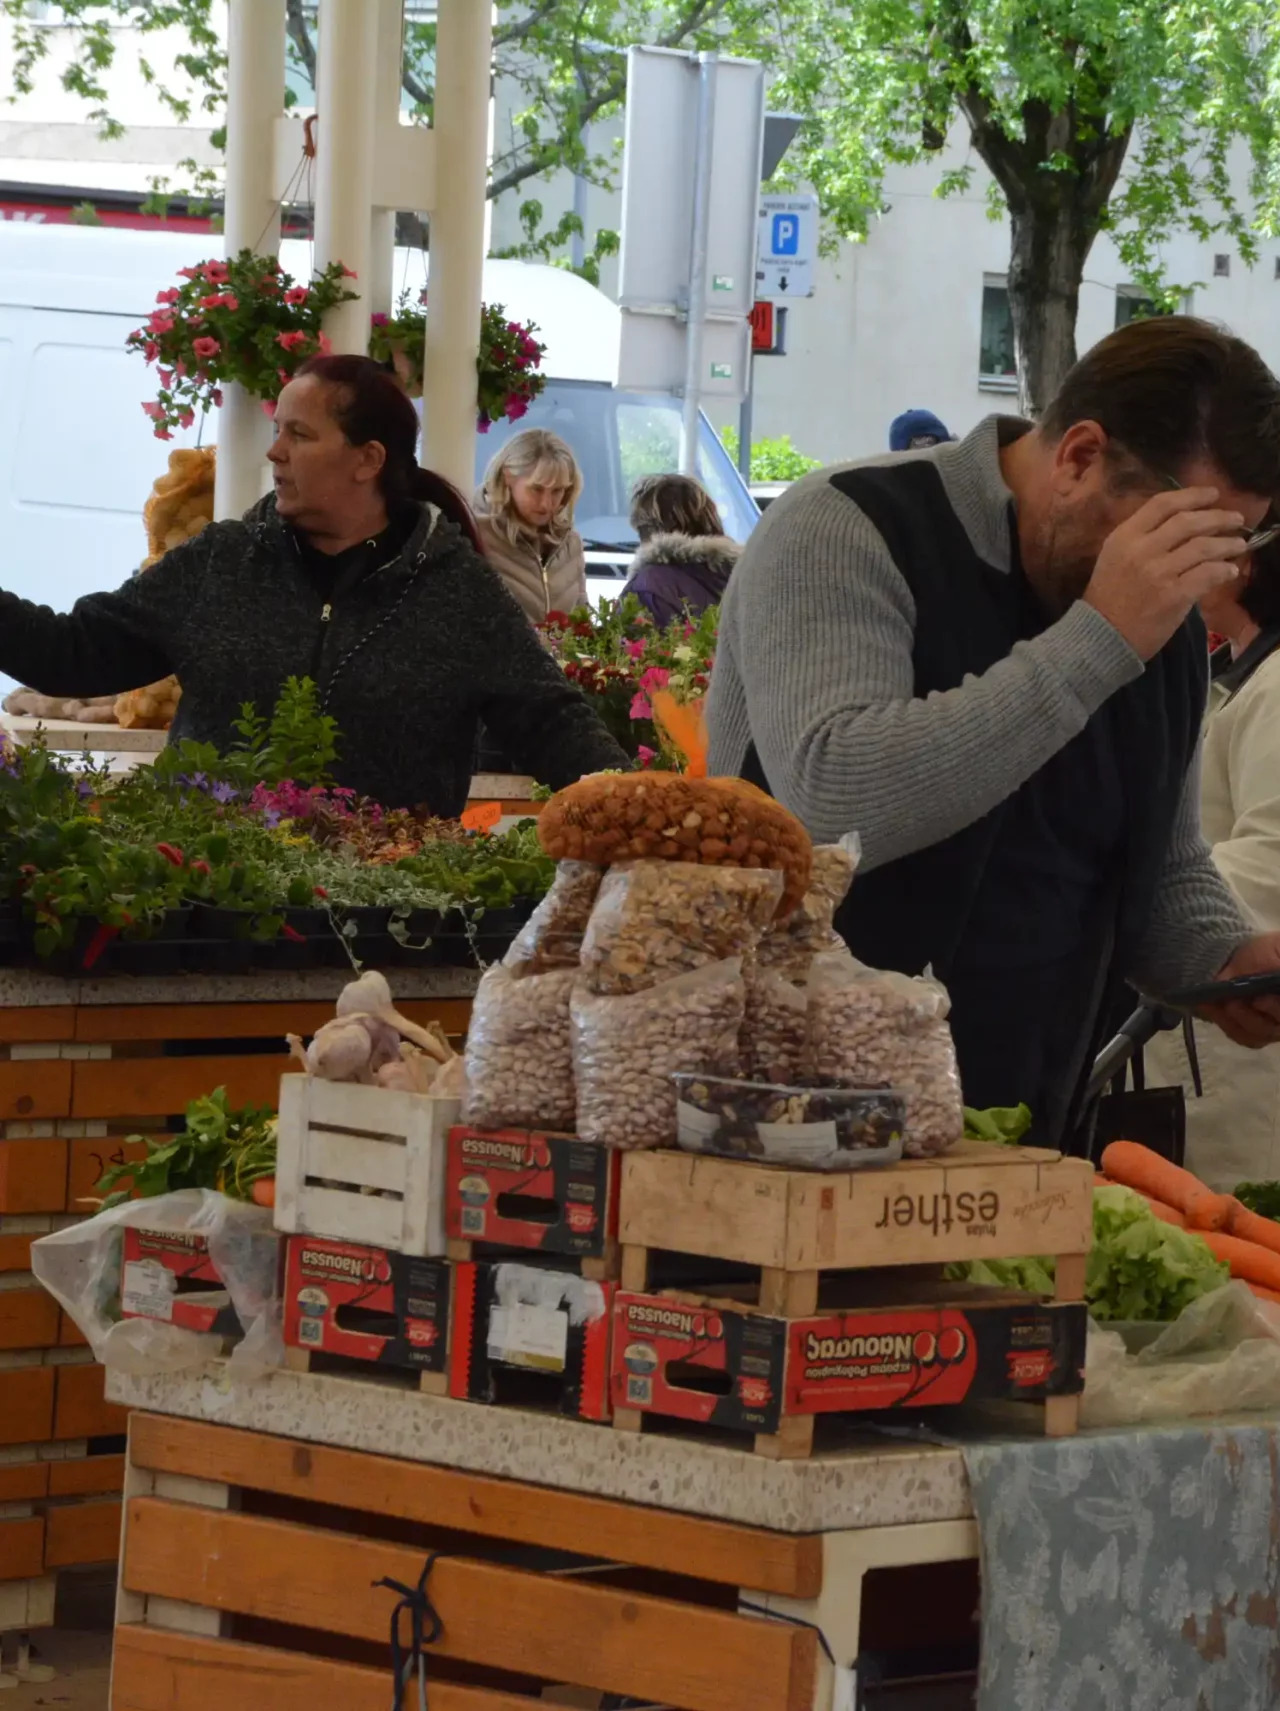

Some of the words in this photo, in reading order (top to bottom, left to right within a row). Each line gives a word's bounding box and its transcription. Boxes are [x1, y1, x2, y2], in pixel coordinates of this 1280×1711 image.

[778, 220, 794, 249] P
[462, 1139, 521, 1163] Naoussa
[875, 1190, 1000, 1237] esther
[302, 1250, 361, 1276] Naoussa
[628, 1305, 692, 1333] Naoussa
[806, 1333, 912, 1363] Νάουσας
[1014, 1363, 1045, 1378] ACN
